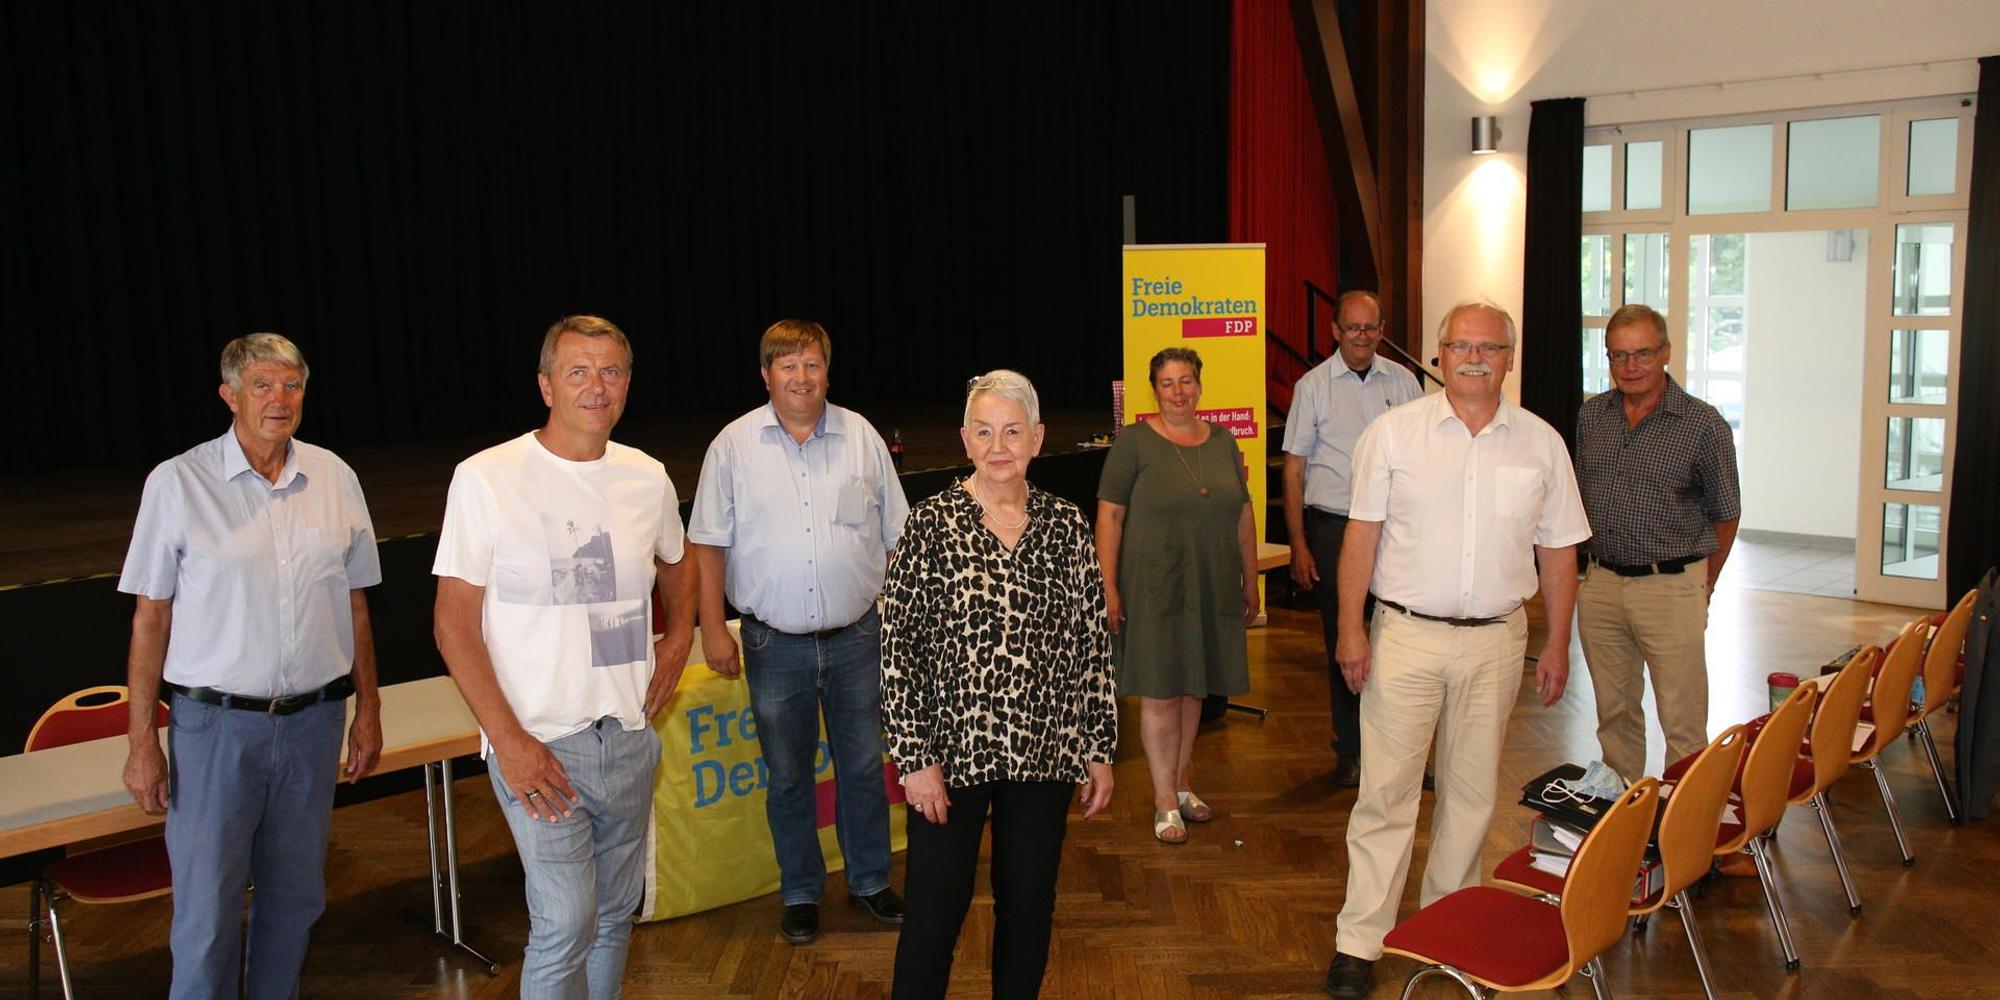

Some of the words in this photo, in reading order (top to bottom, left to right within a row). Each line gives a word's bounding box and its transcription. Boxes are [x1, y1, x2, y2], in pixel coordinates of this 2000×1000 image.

[1132, 276, 1182, 296] Freie
[1132, 296, 1257, 317] Demokraten
[1225, 320, 1253, 333] FDP
[1211, 412, 1218, 422] in
[1219, 412, 1230, 422] der
[686, 705, 759, 754] Fre
